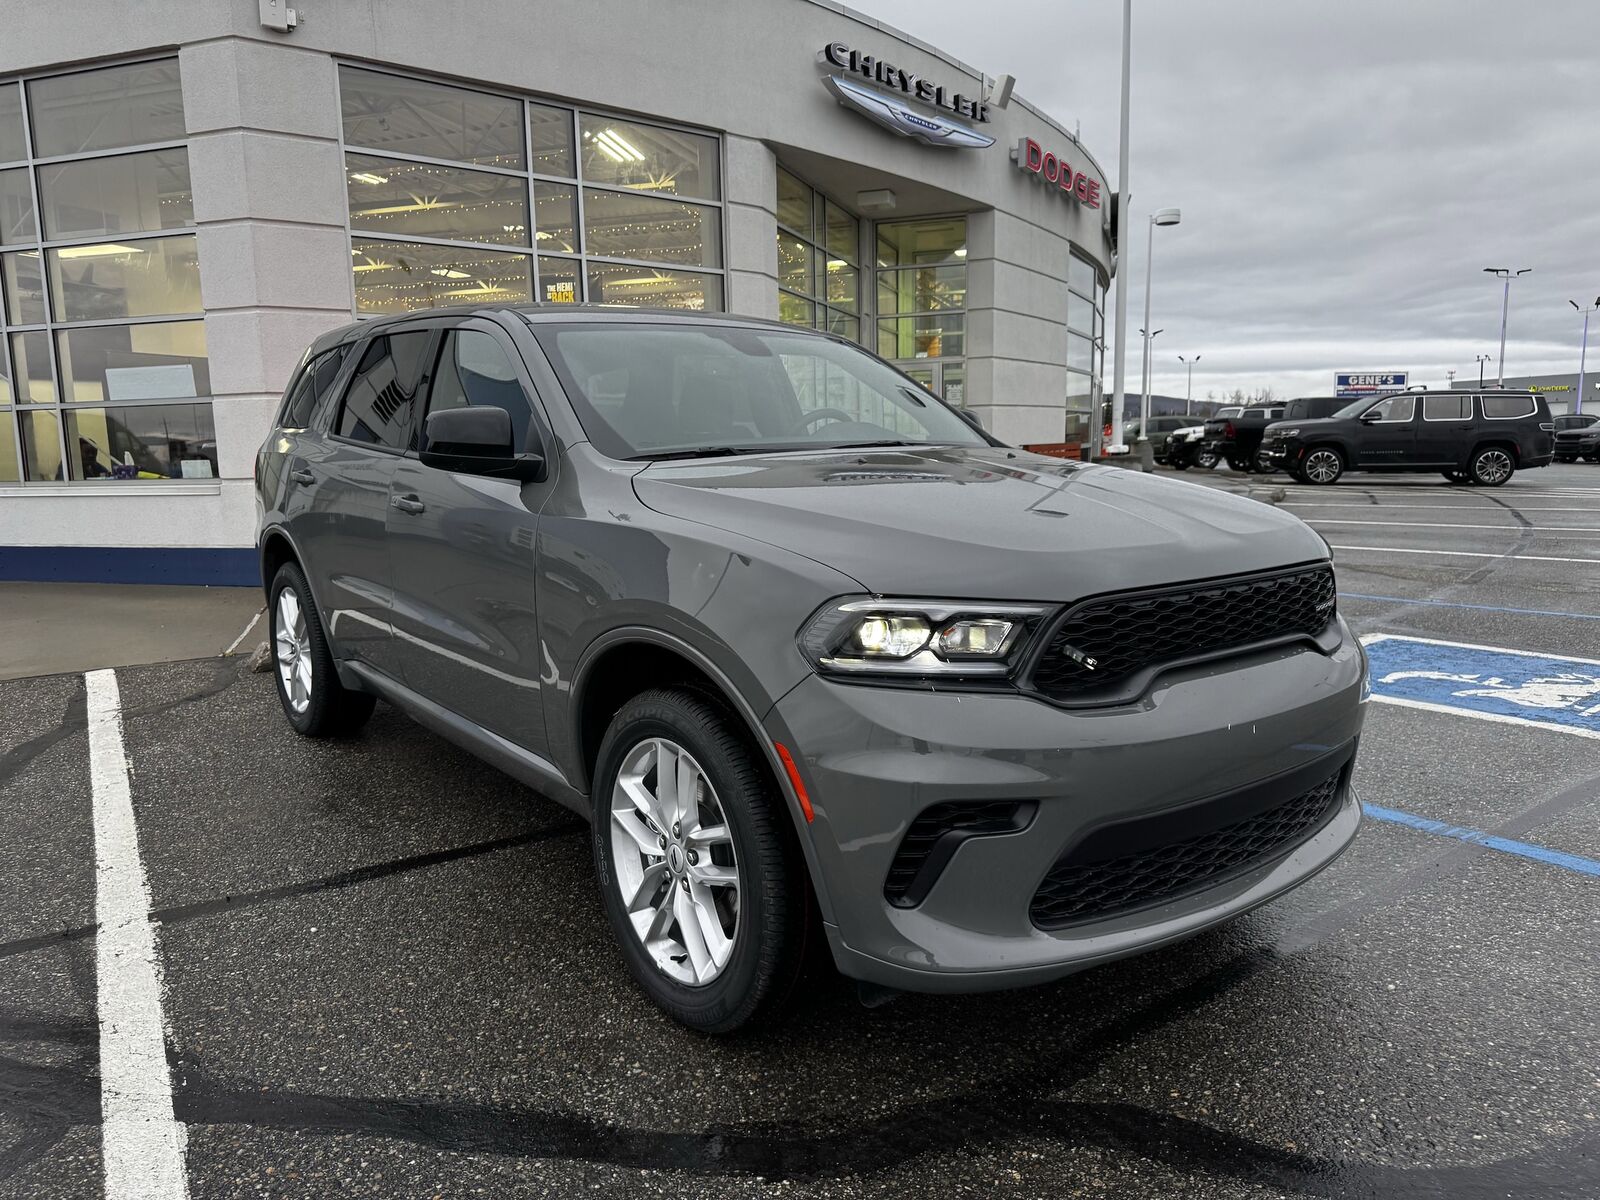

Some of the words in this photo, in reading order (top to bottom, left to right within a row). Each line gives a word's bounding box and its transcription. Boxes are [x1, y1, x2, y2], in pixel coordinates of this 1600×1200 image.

[824, 41, 991, 123] CHRYSLER
[1020, 137, 1100, 209] DODGE
[1348, 375, 1394, 385] GENE'S
